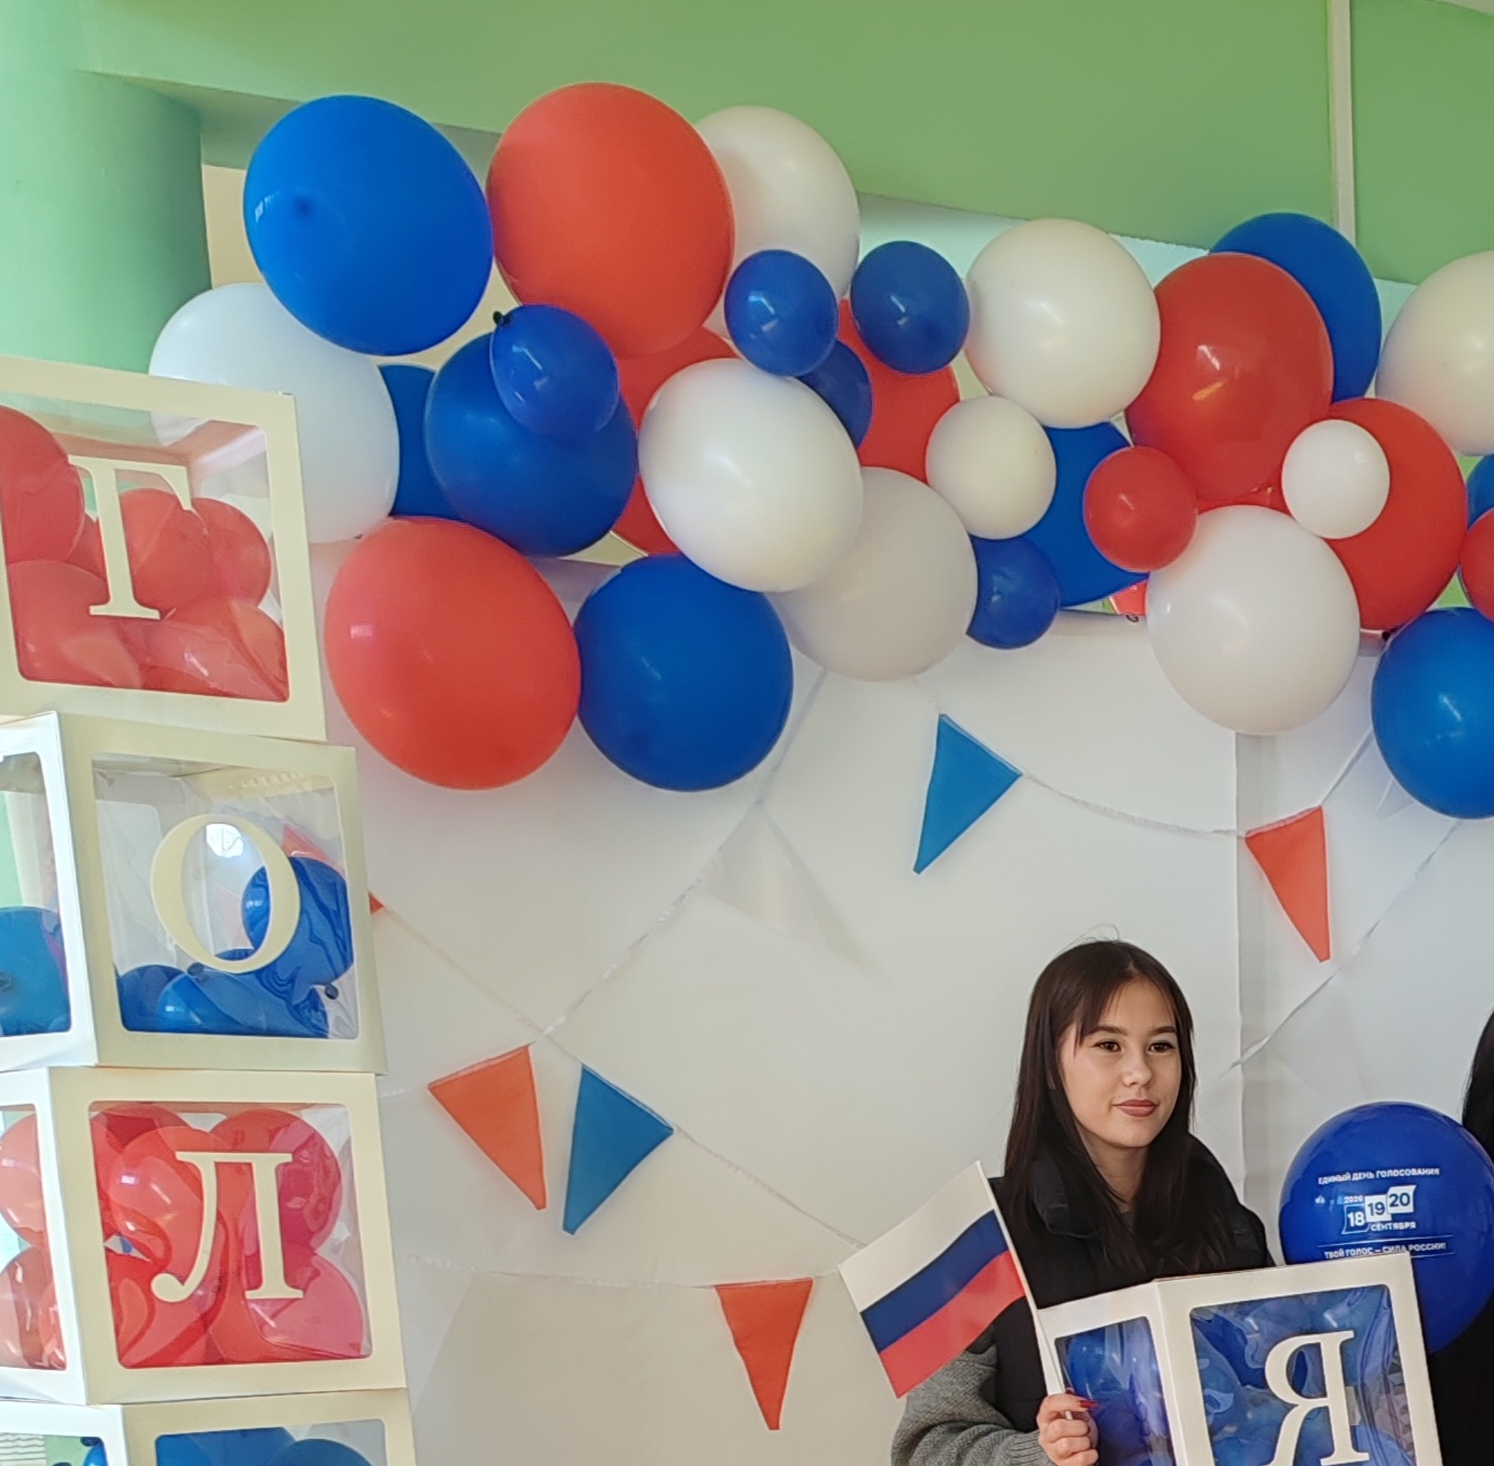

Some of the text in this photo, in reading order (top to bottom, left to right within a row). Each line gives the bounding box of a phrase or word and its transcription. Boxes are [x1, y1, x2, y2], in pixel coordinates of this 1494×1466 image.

[1318, 1168, 1440, 1185] ЕДИНЫЙ ДЕНЬ ГОЛОСОВАНИЯ
[1343, 1195, 1364, 1204] 2026
[1347, 1192, 1411, 1228] 18 19 20
[1370, 1221, 1417, 1232] СЕНТЯБРЯ
[1324, 1247, 1344, 1260] ТВОЙ
[1345, 1247, 1374, 1257] ГОЛОС
[1382, 1245, 1409, 1254] СИЛА
[1409, 1242, 1447, 1252] РОССИИ!
